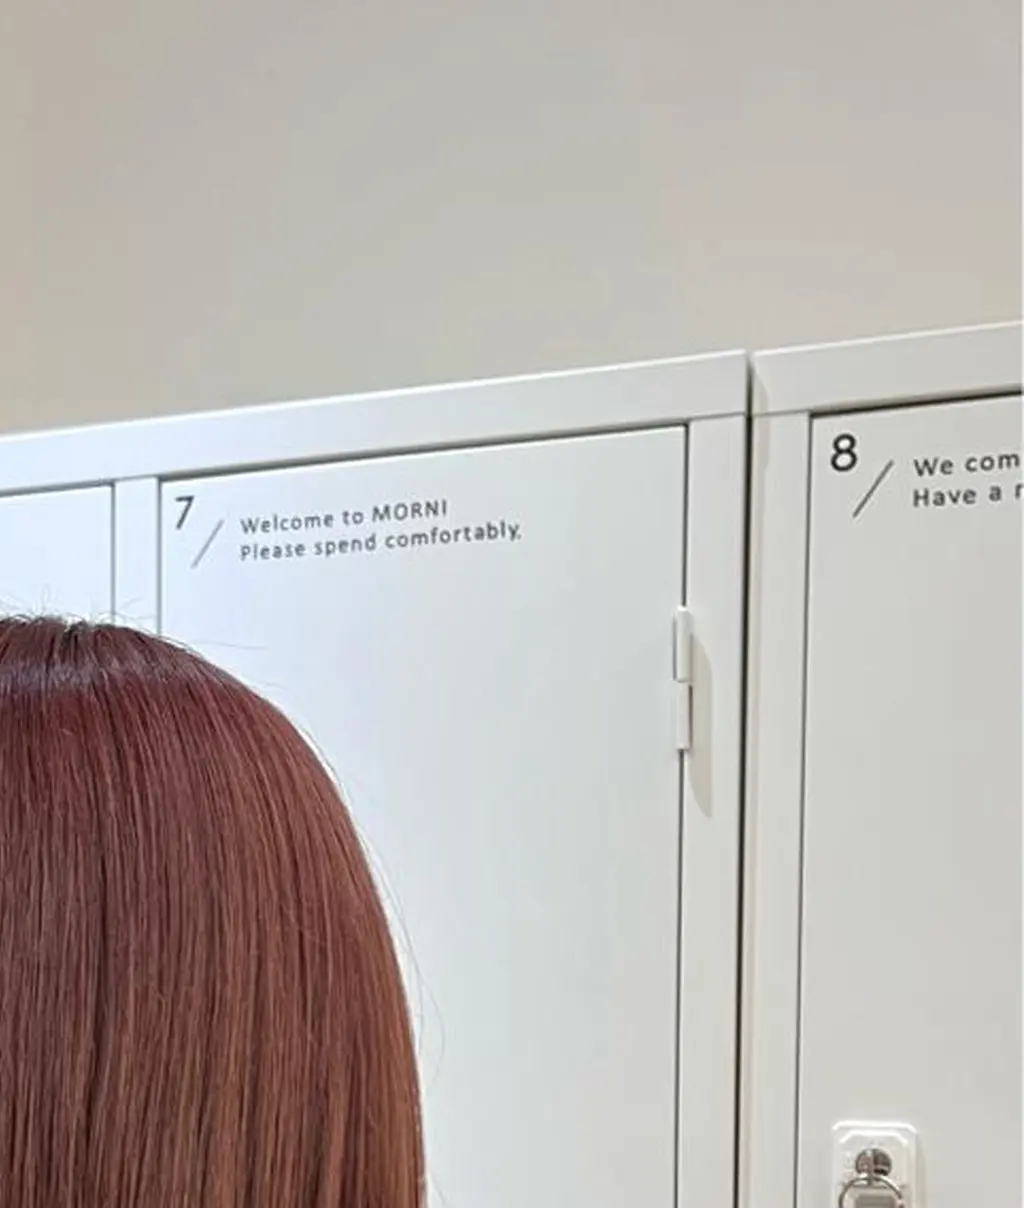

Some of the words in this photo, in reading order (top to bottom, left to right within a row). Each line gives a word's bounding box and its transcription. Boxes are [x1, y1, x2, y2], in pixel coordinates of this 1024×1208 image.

[831, 434, 857, 472] 8
[175, 495, 195, 530] 7
[912, 488, 977, 508] Have
[988, 486, 1002, 502] a
[240, 514, 334, 535] Welcome
[342, 510, 364, 526] to
[372, 498, 447, 523] MORNI
[240, 543, 306, 562] Please
[314, 533, 377, 558] spend
[384, 519, 522, 549] comfortably.
